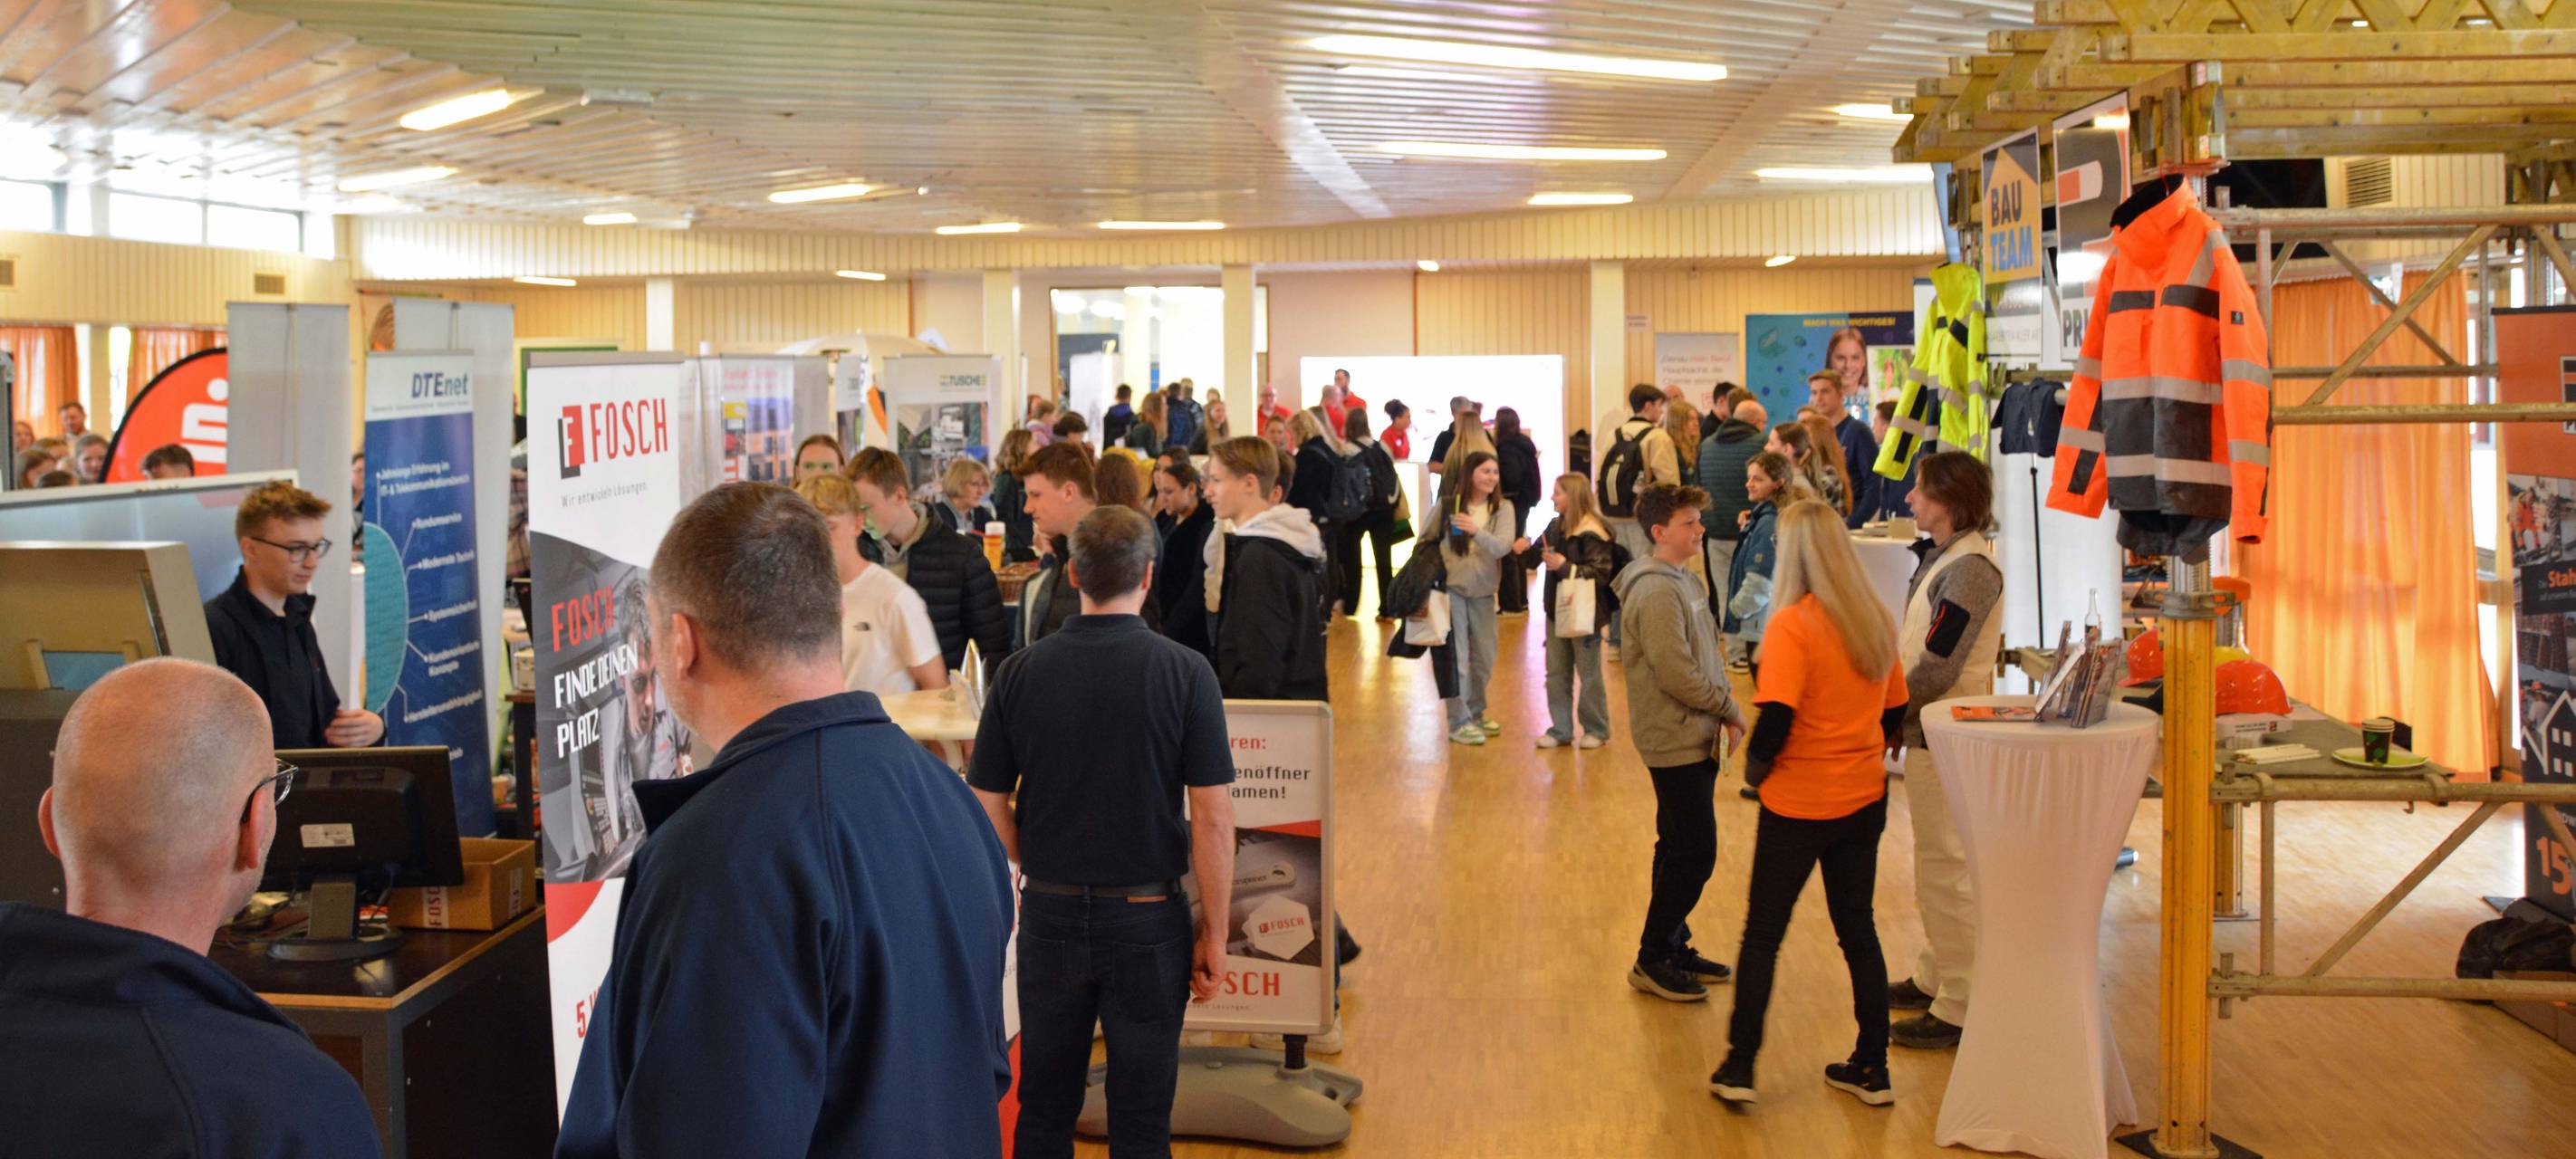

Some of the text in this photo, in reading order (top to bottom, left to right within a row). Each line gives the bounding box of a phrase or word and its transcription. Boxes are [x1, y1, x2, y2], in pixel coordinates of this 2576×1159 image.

[1991, 180, 2023, 226] BAU
[1990, 225, 2033, 273] TEAM
[411, 372, 468, 398] DTEnet
[590, 398, 668, 463] FOSCH
[552, 584, 615, 653] FOSCH
[554, 641, 639, 709] FINDE DEINEN
[557, 708, 600, 759] PLATZ
[1227, 786, 1286, 799] amen!
[576, 1000, 586, 1039] 5
